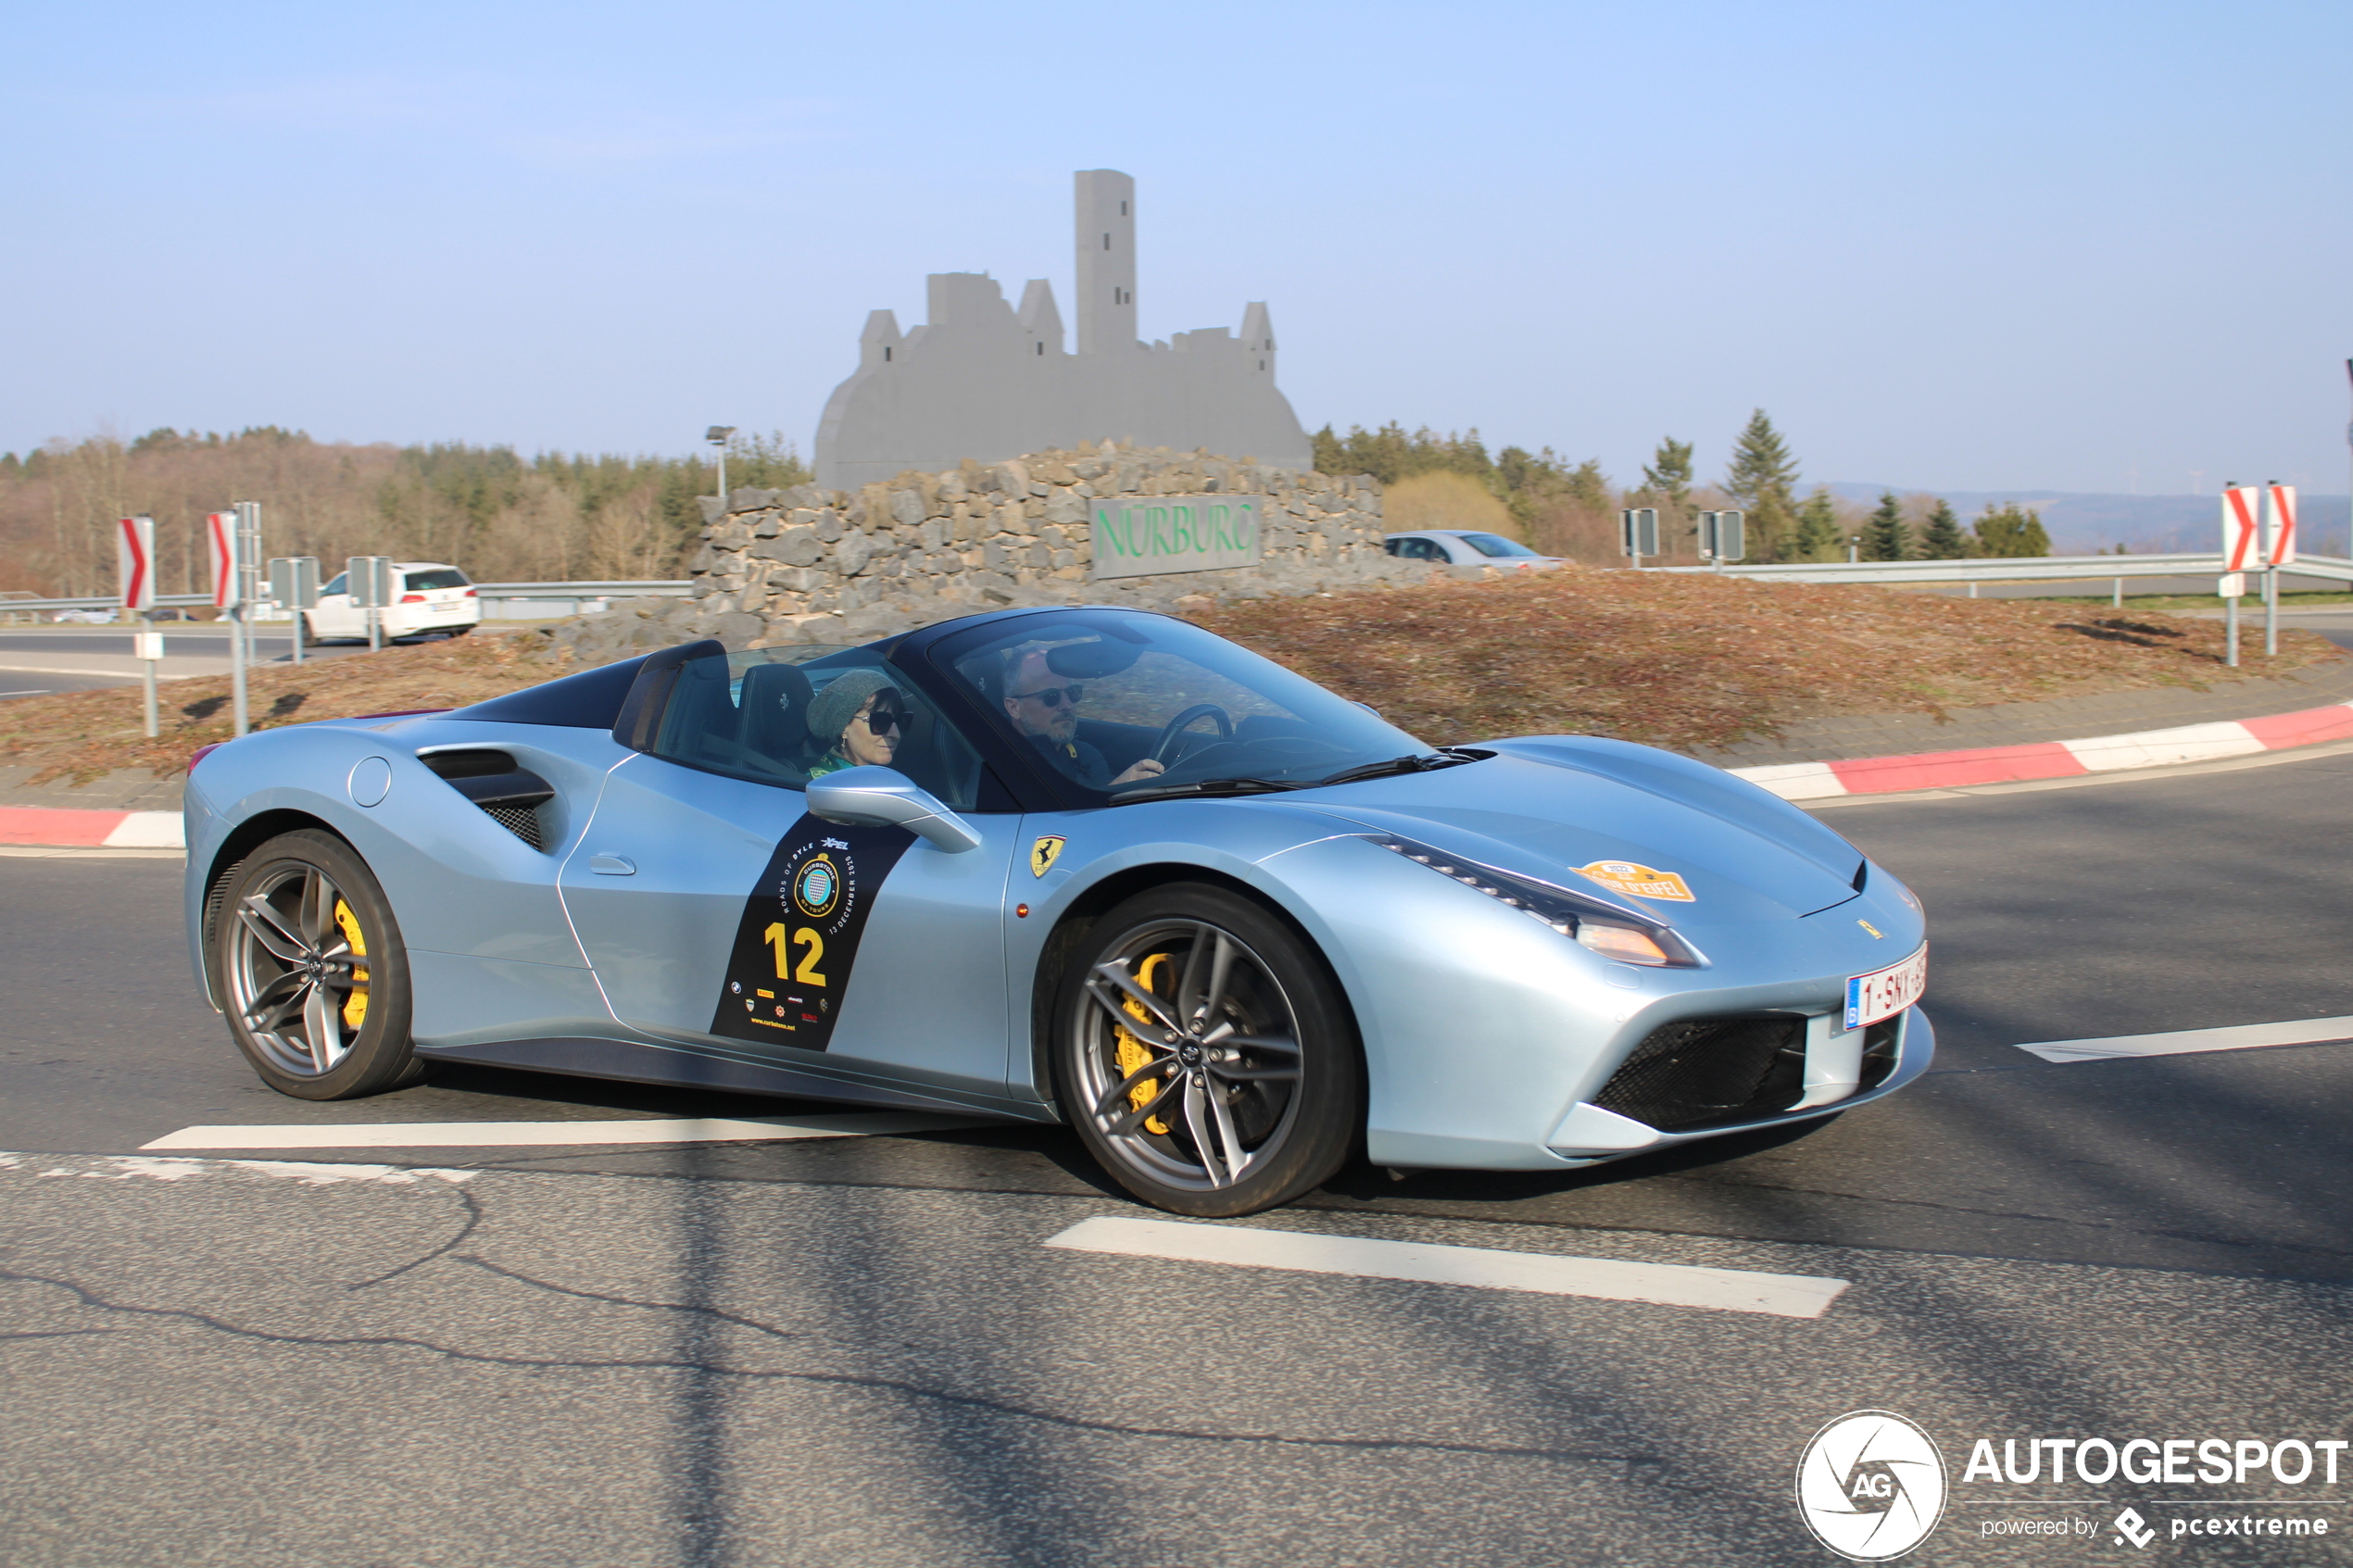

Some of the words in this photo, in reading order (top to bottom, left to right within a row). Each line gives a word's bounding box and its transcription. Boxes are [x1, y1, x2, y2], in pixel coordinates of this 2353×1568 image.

[821, 837, 849, 850] XPEL
[784, 862, 793, 875] OF
[803, 862, 836, 882] CURBSTONE
[779, 880, 790, 914] ROADS
[1625, 880, 1686, 897] D'EIFEL
[837, 879, 856, 928] DECEMBER
[764, 922, 826, 987] 12
[1848, 1007, 1857, 1024] B
